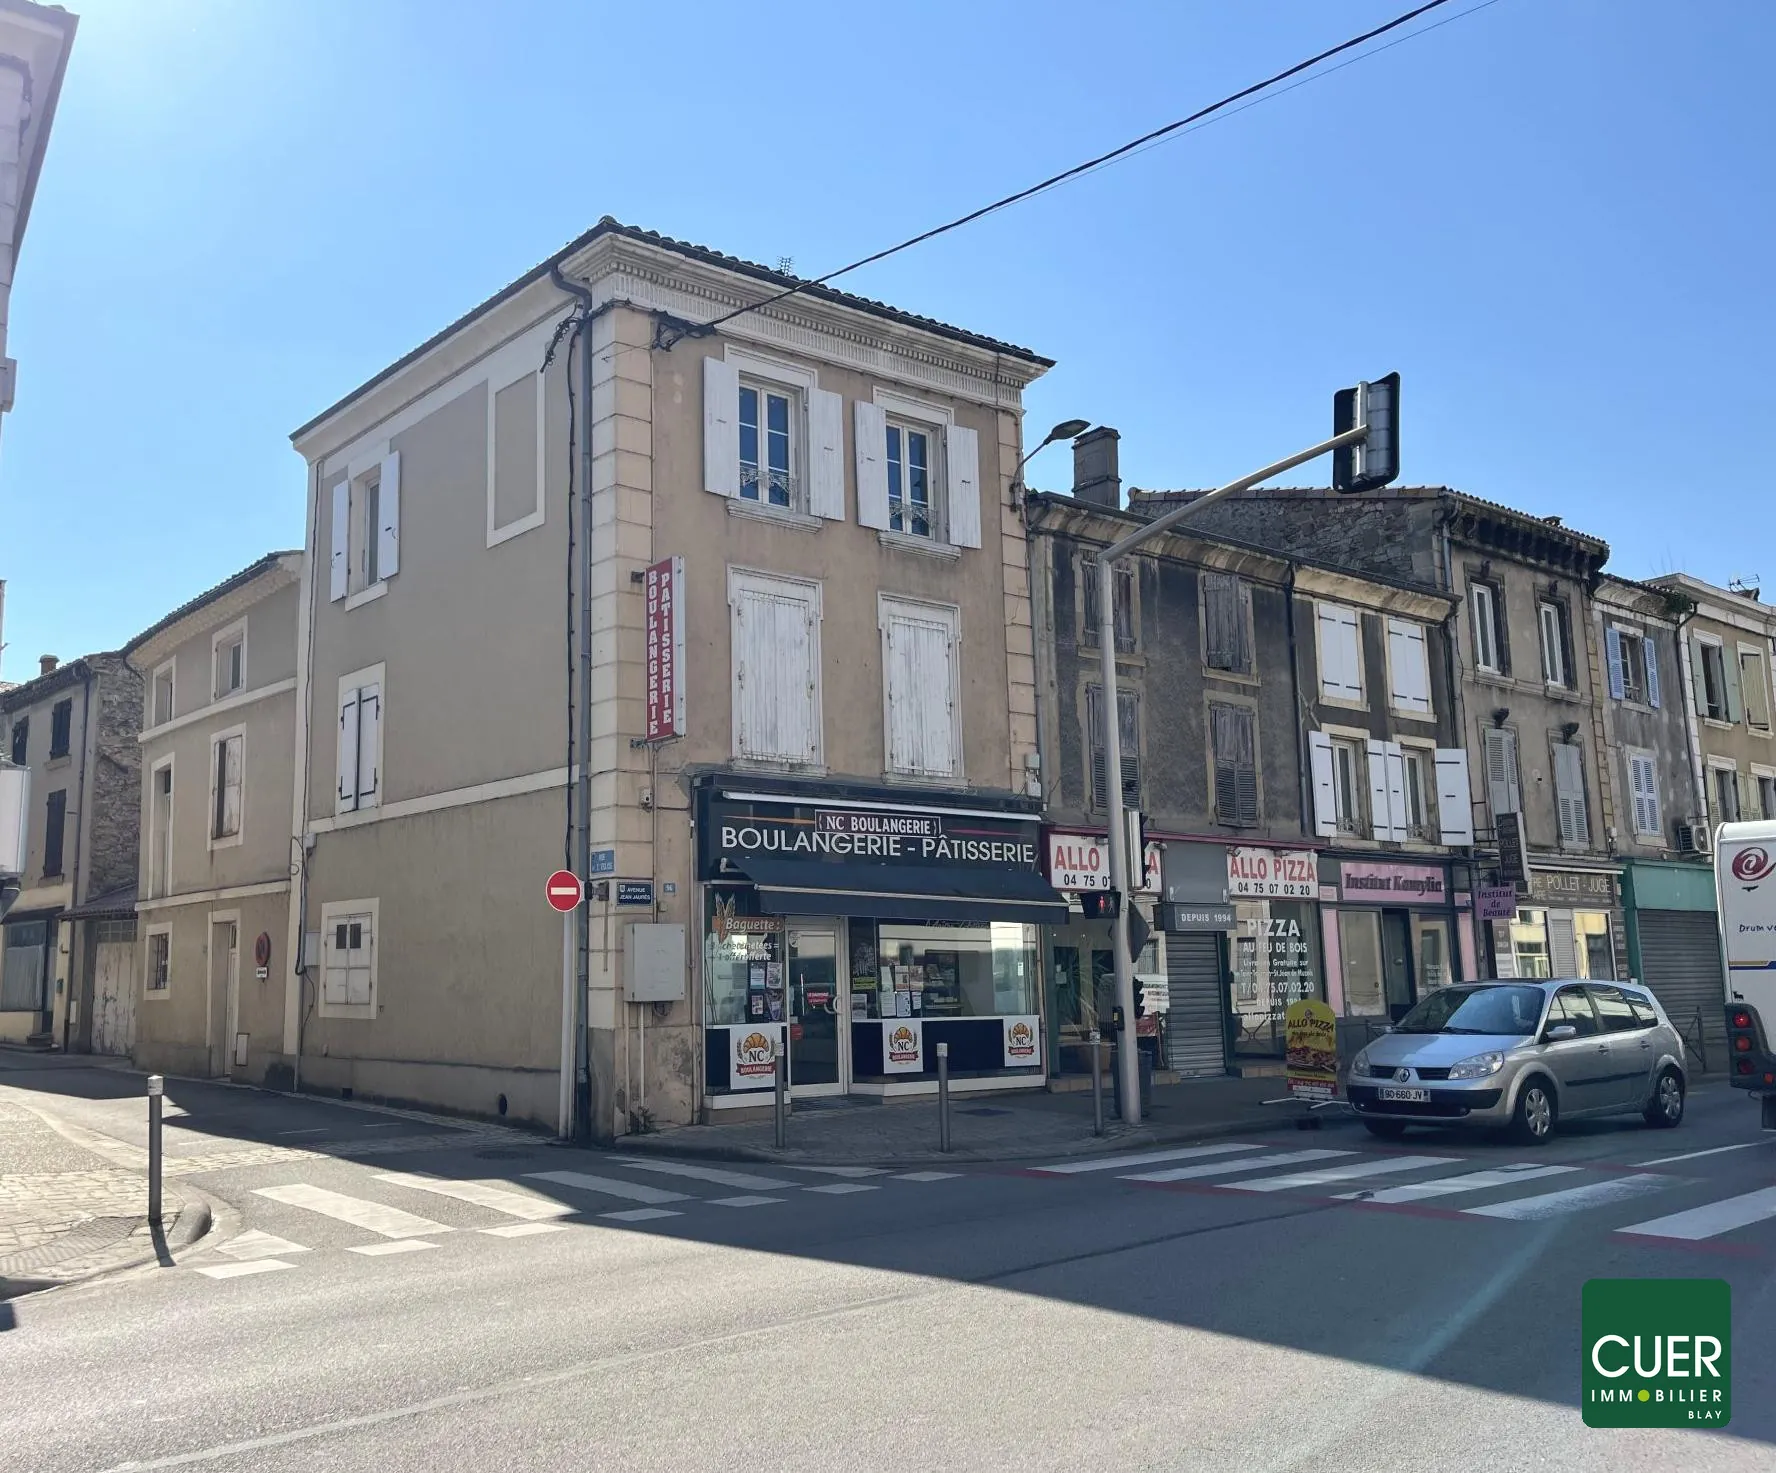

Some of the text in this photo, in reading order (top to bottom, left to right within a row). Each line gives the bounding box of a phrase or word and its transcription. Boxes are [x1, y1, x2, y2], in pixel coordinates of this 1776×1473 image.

[648, 570, 658, 736] BOULANGERIE
[661, 572, 672, 725] PATISSERIE
[826, 815, 931, 835] NC BOULANGERIE
[722, 826, 902, 856] BOULANGERIE
[922, 834, 1034, 863] PÂTISSERIE
[1055, 845, 1100, 872] ALLO
[1230, 857, 1316, 882] ALLO PIZZA
[1064, 874, 1077, 886] 04
[1083, 875, 1095, 887] 75
[1345, 873, 1391, 890] Institut
[1546, 874, 1580, 891] POLLET
[1588, 878, 1611, 893] JUGE
[1238, 881, 1248, 893] 04
[1253, 882, 1264, 894] 75
[1269, 883, 1279, 895] 07
[1283, 884, 1294, 895] 02
[1299, 884, 1310, 896] 20
[1478, 889, 1512, 899] Institut
[1490, 899, 1500, 908] de
[1181, 912, 1232, 923] DEPUIS 1994
[1483, 908, 1512, 918] Beauté
[1247, 919, 1301, 937] PIZZA
[1739, 924, 1764, 933] Drum
[1243, 942, 1255, 953] AU
[1275, 942, 1286, 953] DE
[1289, 942, 1308, 953] BOIS
[1288, 1018, 1307, 1029] ALLO
[897, 1041, 909, 1051] NC
[1015, 1036, 1027, 1046] NC
[748, 1050, 765, 1063] NC
